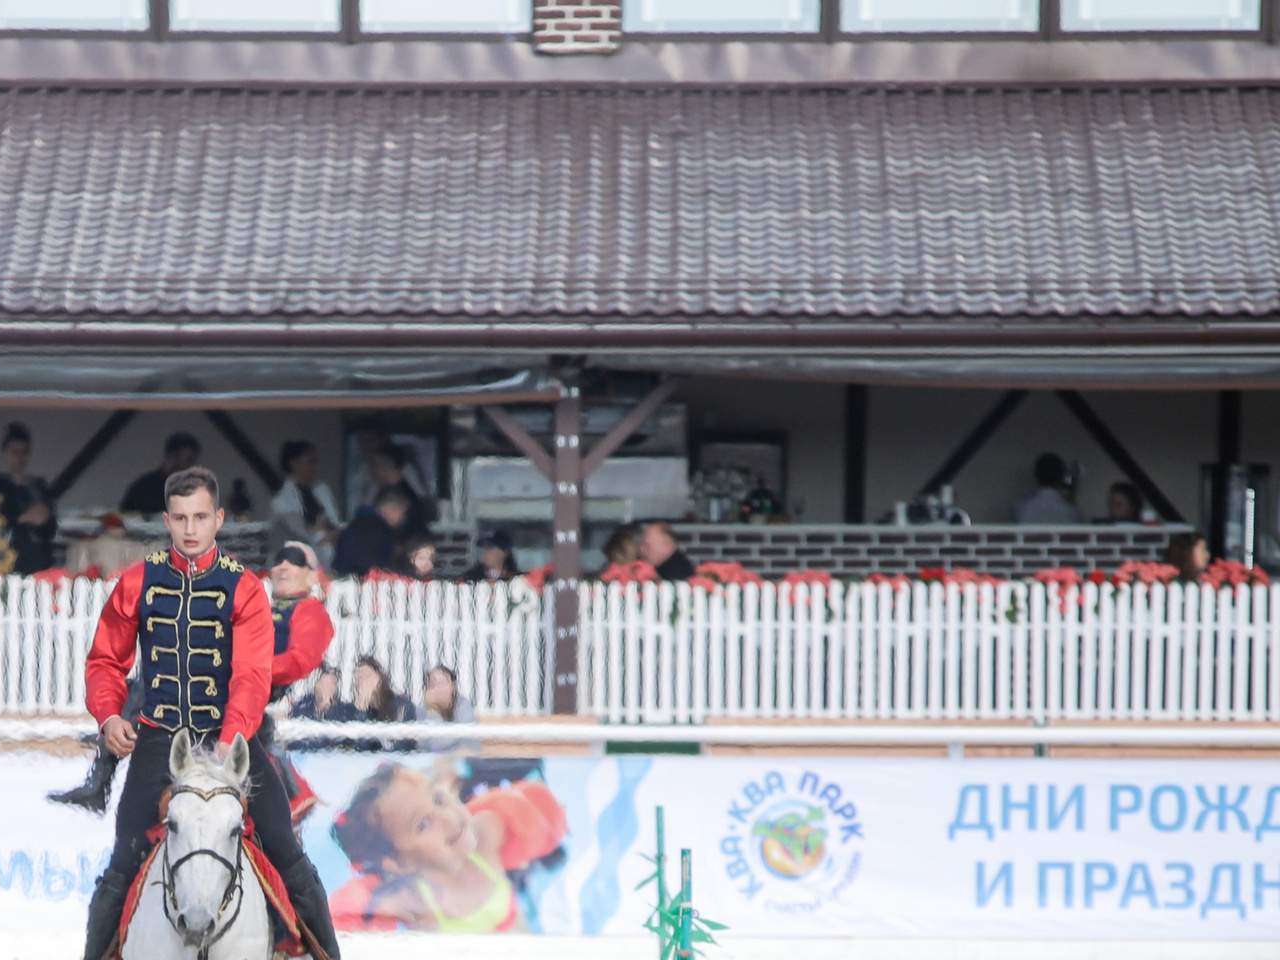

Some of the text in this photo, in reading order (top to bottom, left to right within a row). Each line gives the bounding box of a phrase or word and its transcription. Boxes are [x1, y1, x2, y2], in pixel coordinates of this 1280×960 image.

[798, 771, 865, 845] ПАРК
[948, 783, 1085, 841] ДНИ
[975, 861, 1280, 920] И ПРАЗДН
